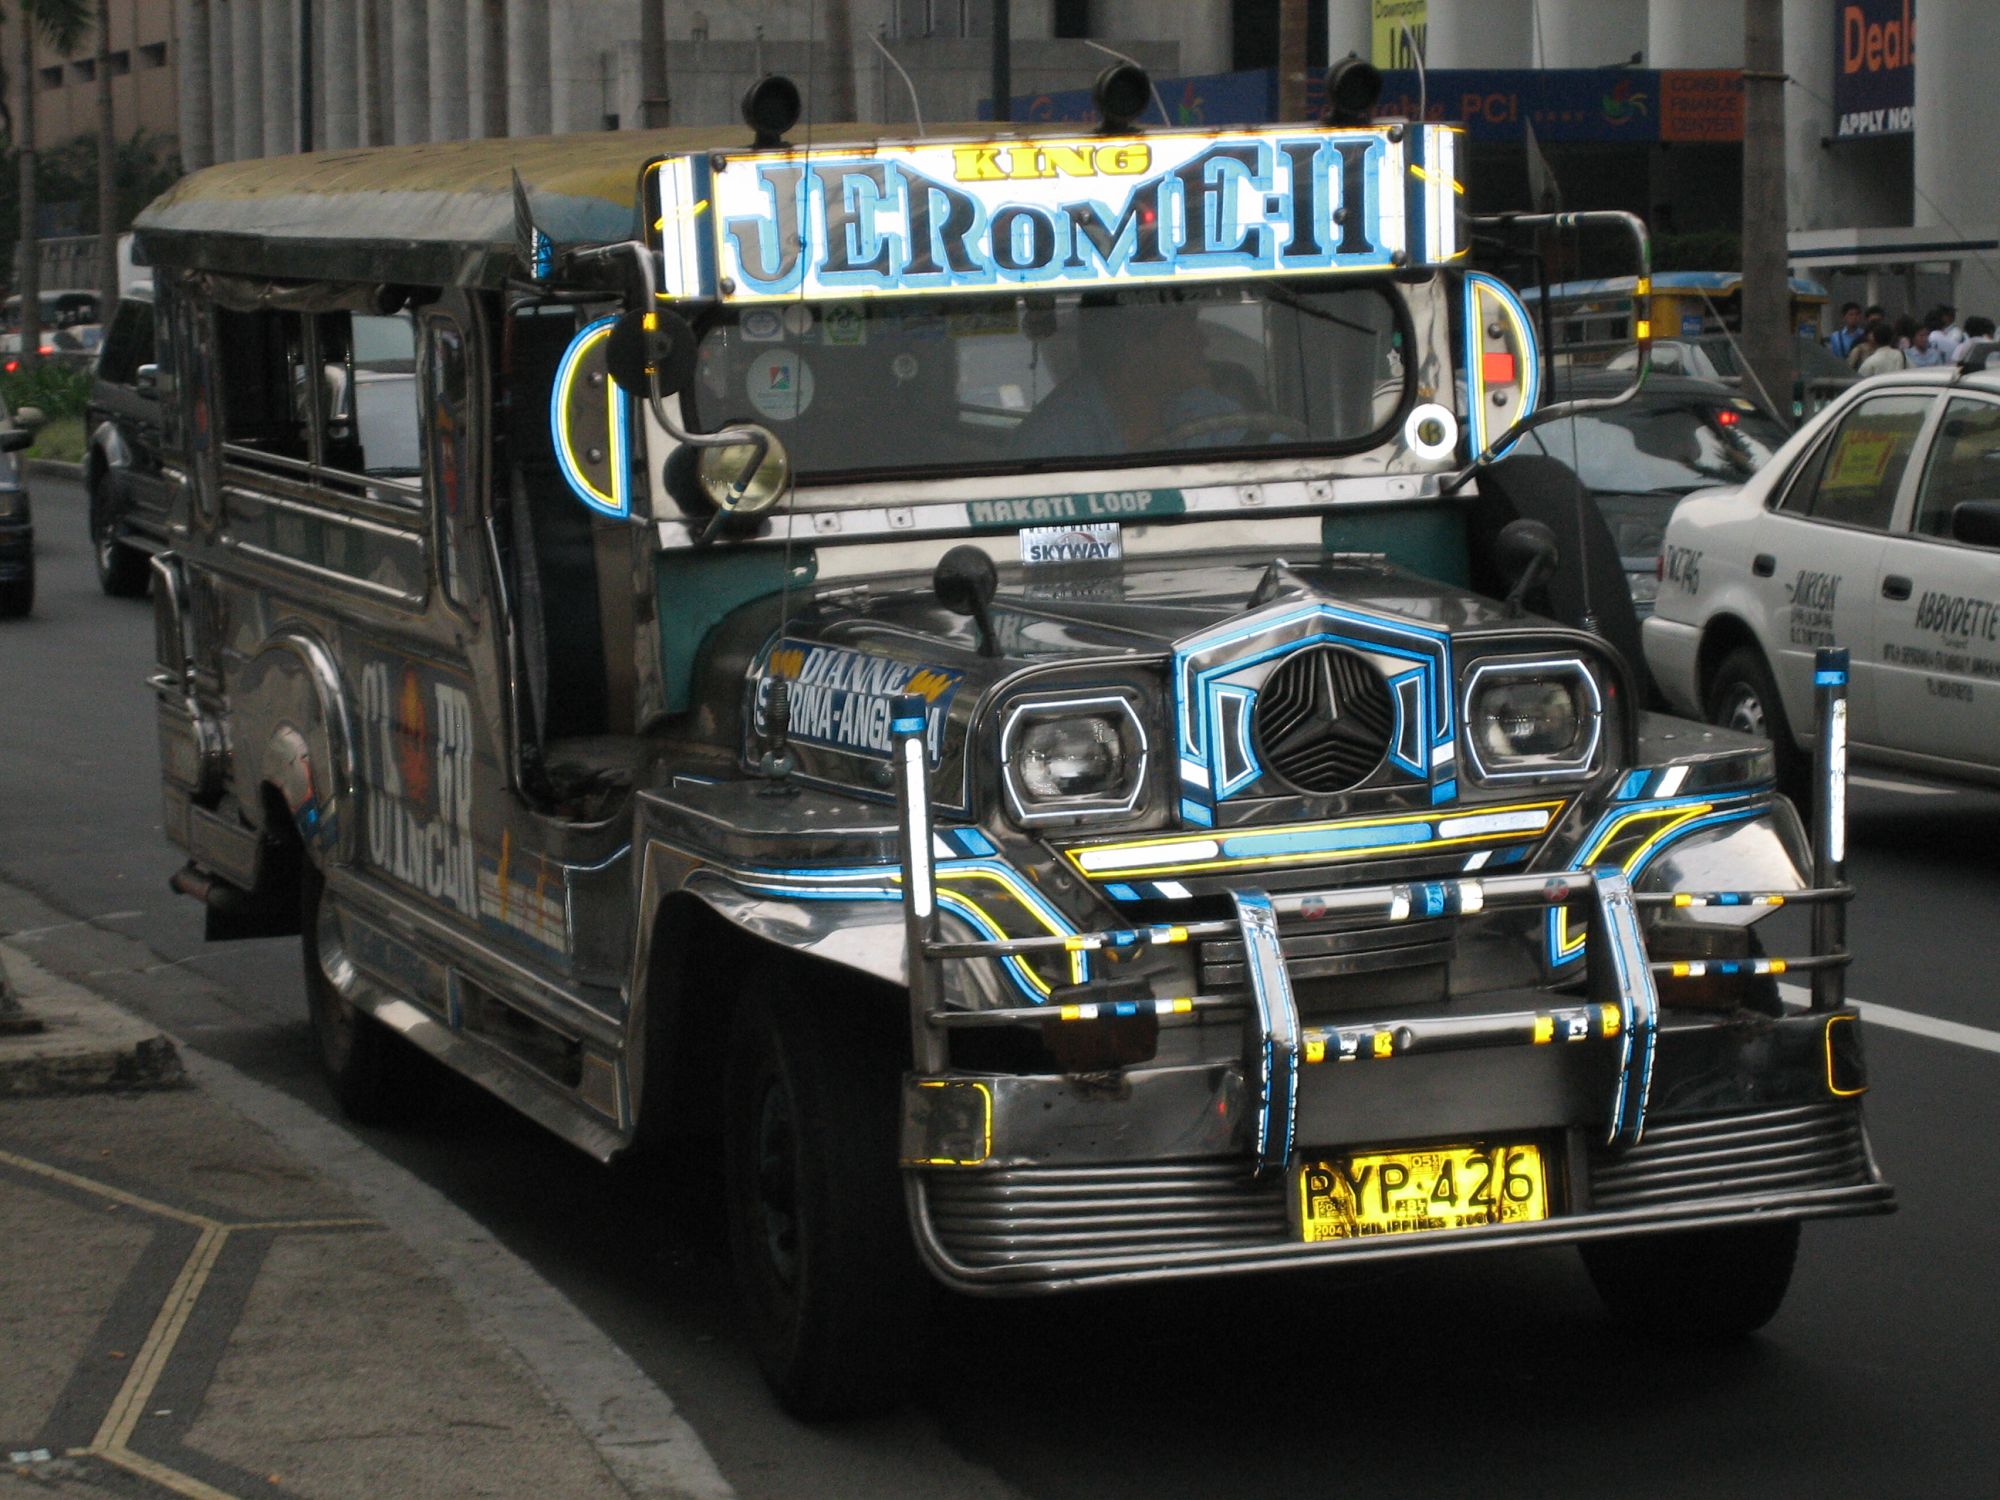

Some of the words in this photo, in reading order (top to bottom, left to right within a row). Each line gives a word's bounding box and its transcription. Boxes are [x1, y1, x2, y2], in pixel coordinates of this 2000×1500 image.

[1461, 93, 1518, 122] PCI
[1839, 110, 1884, 135] APPLY
[953, 144, 1151, 182] KING
[972, 497, 1076, 522] MAKATI
[1088, 491, 1153, 514] LOOP
[1030, 542, 1113, 560] SKYWAY
[799, 647, 917, 698] DIANNE
[1306, 1162, 1409, 1220] PYP
[1430, 1151, 1534, 1210] 426
